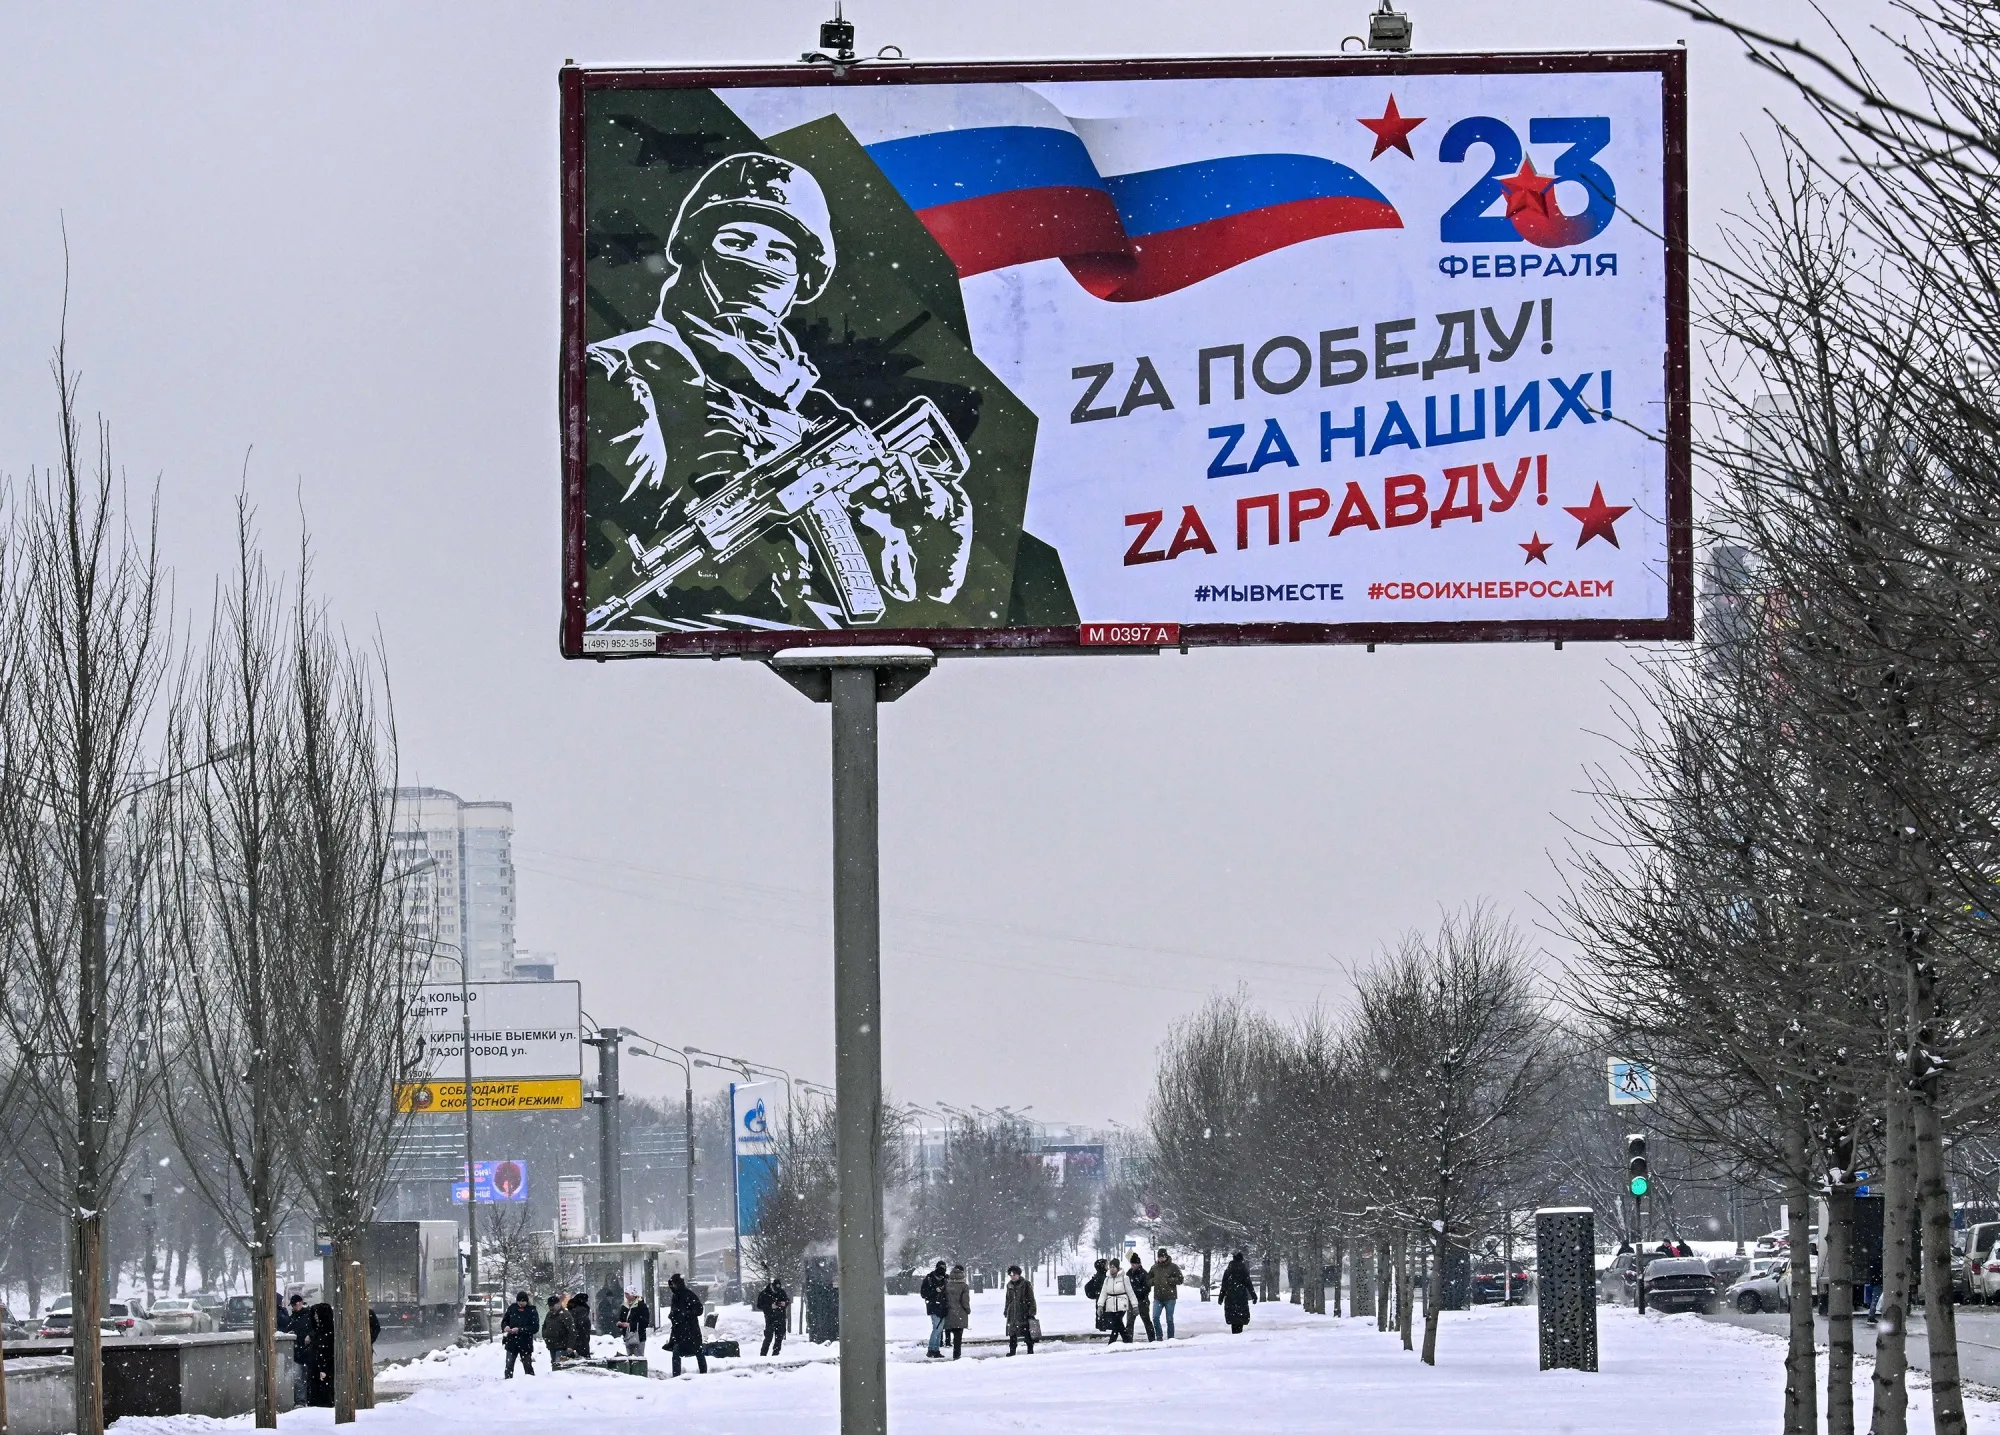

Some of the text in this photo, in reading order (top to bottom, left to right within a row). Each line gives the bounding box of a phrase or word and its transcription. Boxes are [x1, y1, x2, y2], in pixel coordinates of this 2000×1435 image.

[1439, 116, 1616, 248] 23
[1439, 253, 1617, 278] ФЕВРАЛЯ
[1199, 297, 1554, 405] ПОБЕДУ!
[1320, 370, 1613, 463] НАШИХ!
[1237, 454, 1548, 550] ПРАВДУ!
[1195, 580, 1614, 602] #МЫВМЕСТЕ #СВОИХНЕБРОСАЕМ
[1110, 627, 1151, 641] 0397
[588, 638, 653, 649] (495) 952-35-58
[410, 1007, 448, 1017] ЦЕНТР
[505, 1031, 557, 1041] ВЫЕМКИ
[560, 1032, 576, 1042] ул.
[511, 1047, 527, 1057] ул.
[518, 1095, 564, 1106] РЕЖИМ!
